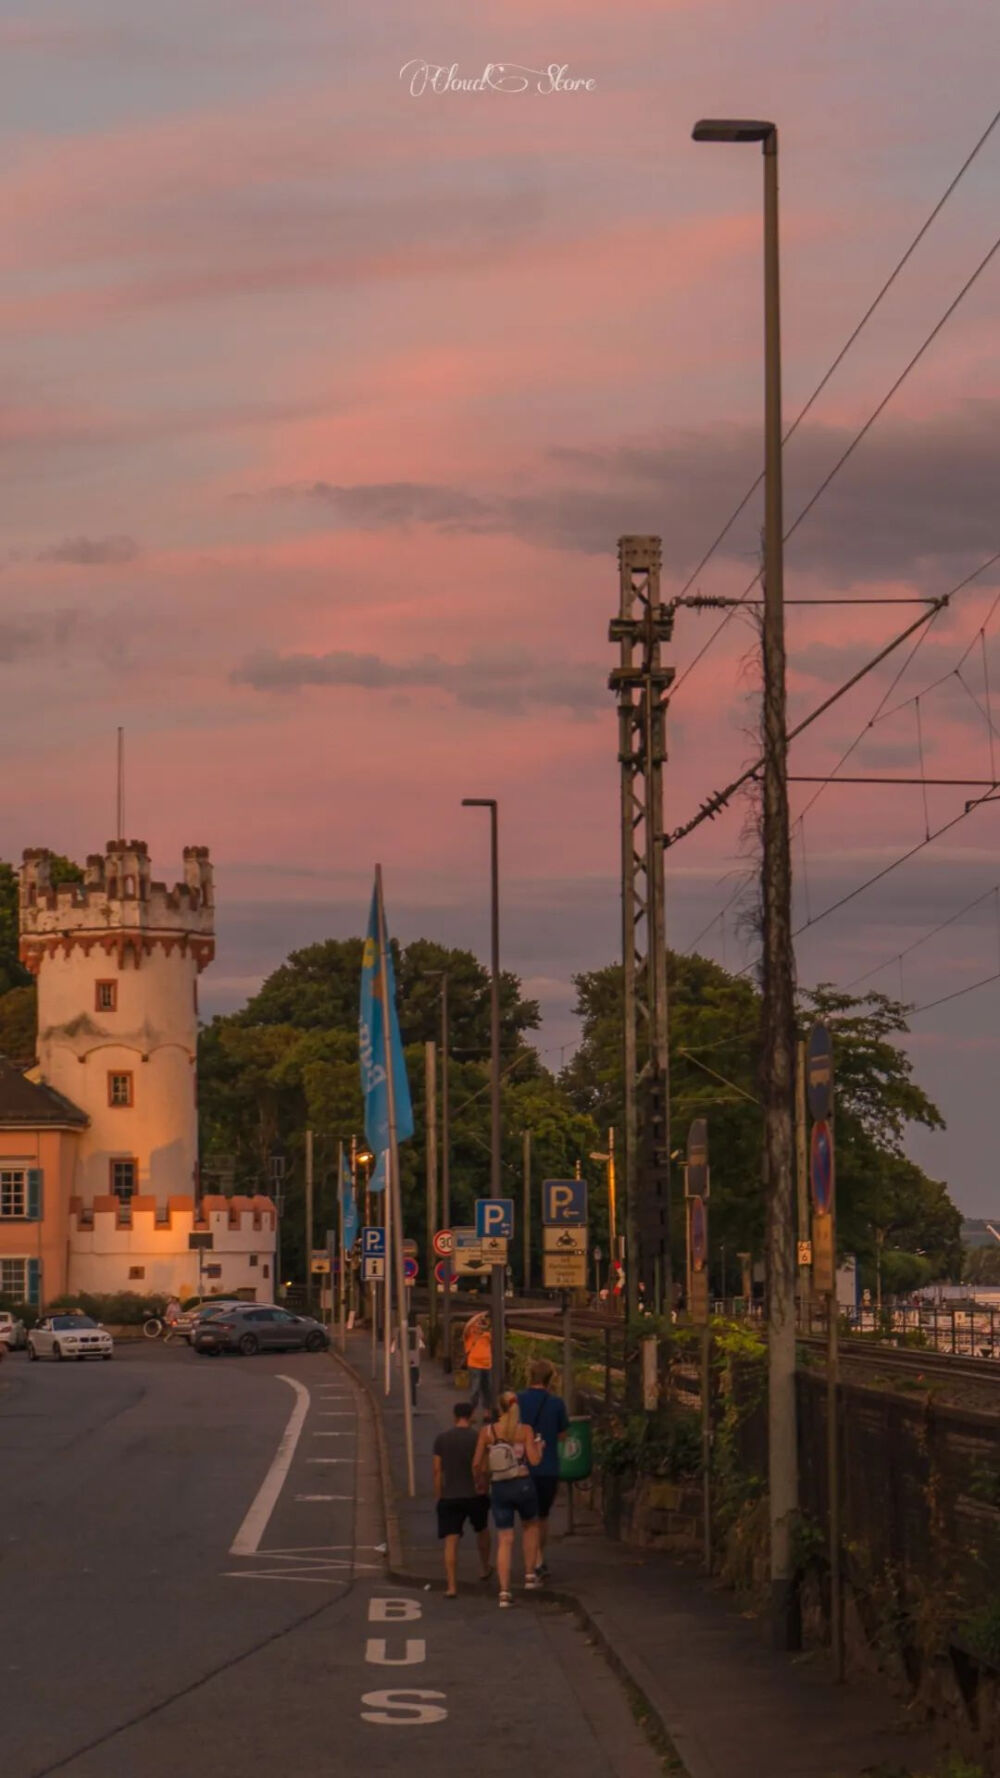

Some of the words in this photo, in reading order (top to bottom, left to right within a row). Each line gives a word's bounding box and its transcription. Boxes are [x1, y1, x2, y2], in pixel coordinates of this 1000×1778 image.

[550, 1185, 573, 1218] P
[484, 1204, 504, 1234] P
[367, 1231, 380, 1250] P
[440, 1237, 453, 1248] 30
[360, 1597, 448, 1724] BUS
